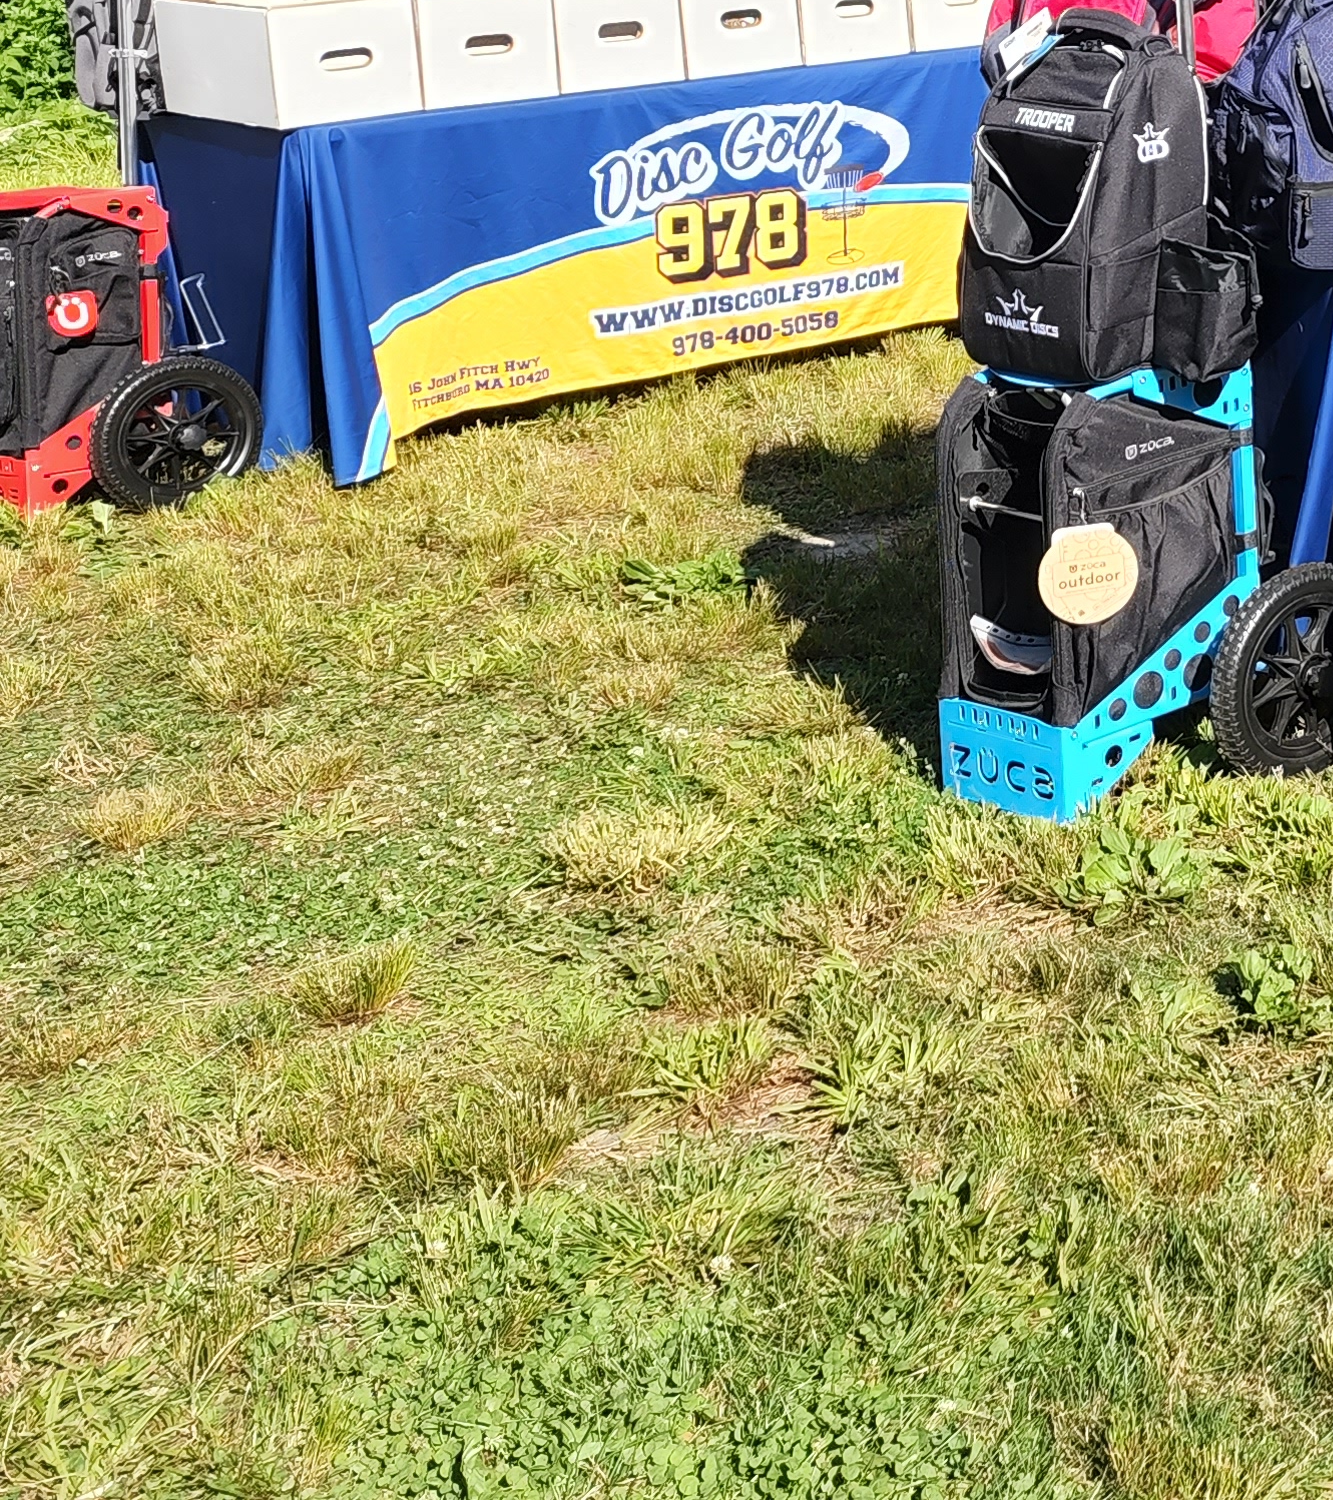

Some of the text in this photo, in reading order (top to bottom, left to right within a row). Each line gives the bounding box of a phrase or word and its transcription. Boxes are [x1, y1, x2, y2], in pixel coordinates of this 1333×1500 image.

[1015, 107, 1076, 133] TROOPER
[594, 103, 836, 220] Disc Golf
[656, 187, 807, 284] 978
[594, 266, 900, 333] WWW.DISCGOLF978.COM
[672, 311, 839, 356] 978-400-5058
[985, 312, 1059, 338] DYNAMIC DISCS
[409, 382, 422, 395] 16
[475, 378, 504, 391] MA
[509, 368, 550, 387] 10420
[1058, 571, 1122, 591] outdoor
